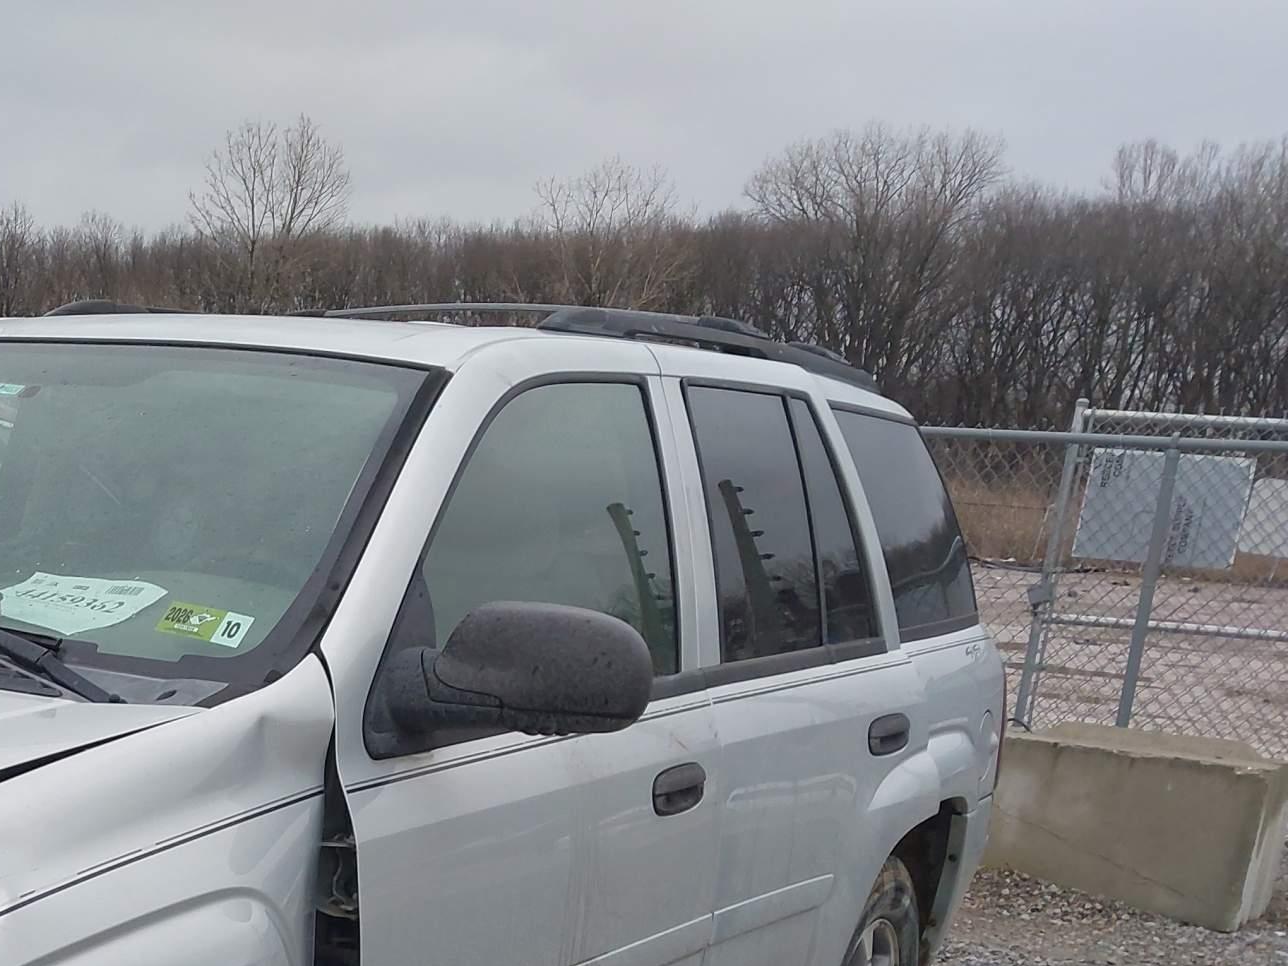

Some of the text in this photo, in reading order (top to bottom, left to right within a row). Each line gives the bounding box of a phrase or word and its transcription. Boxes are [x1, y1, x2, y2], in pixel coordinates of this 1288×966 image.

[15, 588, 125, 613] 44159362
[165, 606, 193, 624] 2026
[221, 620, 241, 639] 10
